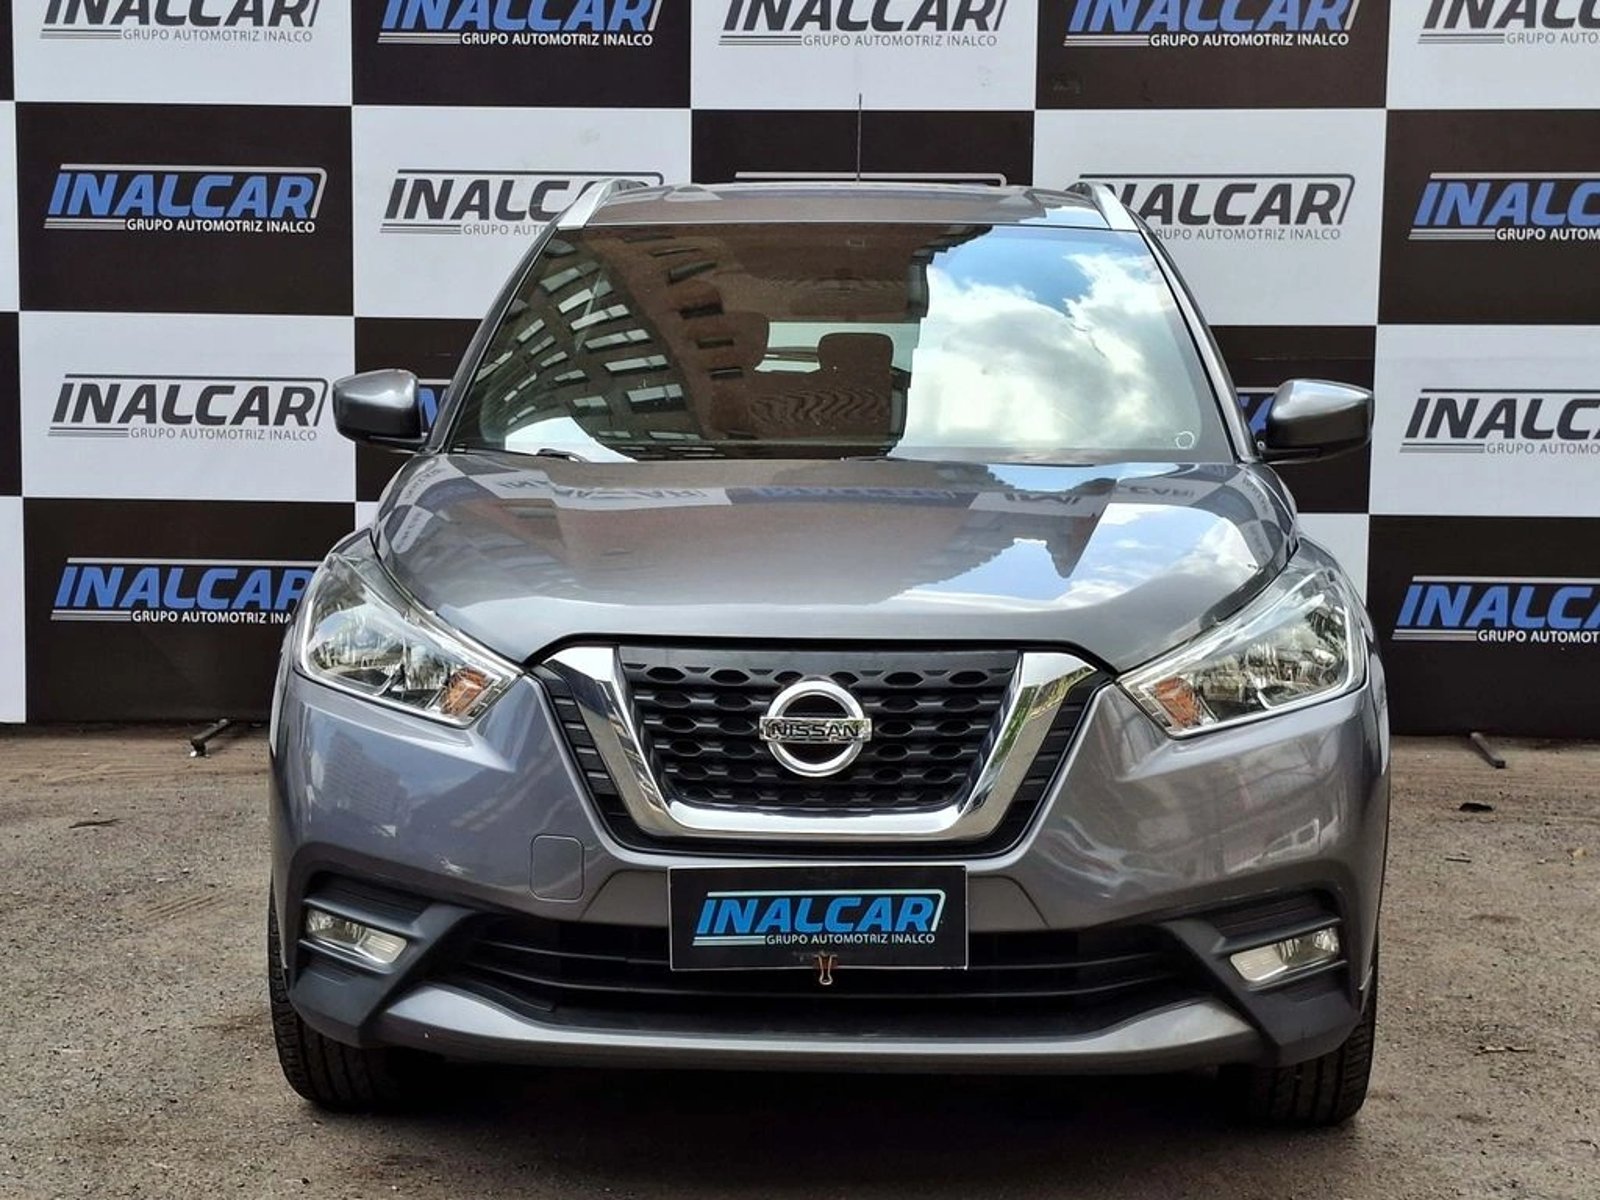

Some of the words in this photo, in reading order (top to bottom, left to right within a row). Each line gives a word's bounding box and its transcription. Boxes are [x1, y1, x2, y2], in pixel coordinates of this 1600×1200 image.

[122, 29, 169, 40] GRUPO
[173, 29, 259, 42] AUTOMOTRIZ
[264, 30, 312, 42] INALCO
[462, 33, 508, 45] GRUPO
[512, 33, 599, 46] AUTOMOTRIZ
[603, 34, 653, 46] INALCO
[804, 35, 850, 46] GRUPO
[854, 35, 942, 46] AUTOMOTRIZ
[947, 35, 997, 47] INALCO
[1150, 34, 1199, 47] GRUPO
[1202, 34, 1293, 46] AUTOMOTRIZ
[1297, 33, 1349, 46] INALCO
[1506, 32, 1555, 44] GRUPO
[48, 173, 314, 218] INALCAR
[384, 178, 598, 222] INALC
[126, 219, 173, 231] GRUPO
[176, 220, 263, 232] AUTOMOTRIZ
[267, 221, 315, 233] INALCO
[463, 224, 509, 235] GRUPO
[1155, 229, 1192, 240] RUPO
[1197, 228, 1285, 240] AUTOMOTRIZ
[1290, 229, 1341, 240] INALCO
[1497, 228, 1546, 240] GRUPO
[52, 383, 315, 426] INALCAR
[1405, 397, 1600, 440] INALC
[130, 428, 176, 439] GRUPO
[180, 429, 265, 440] AUTOMOTRIZ
[269, 430, 317, 441] INALCO
[1487, 443, 1535, 454] GRUPO
[132, 610, 178, 622] GRUPO
[182, 611, 266, 624] AUTOMOTRIZ
[1477, 630, 1526, 642] GRUPO
[771, 723, 860, 737] NISSAN
[696, 897, 934, 934] INALCAR
[766, 934, 808, 945] GRUPO
[811, 934, 887, 945] AUTOMOTRIZ
[891, 933, 936, 944] INALCO
